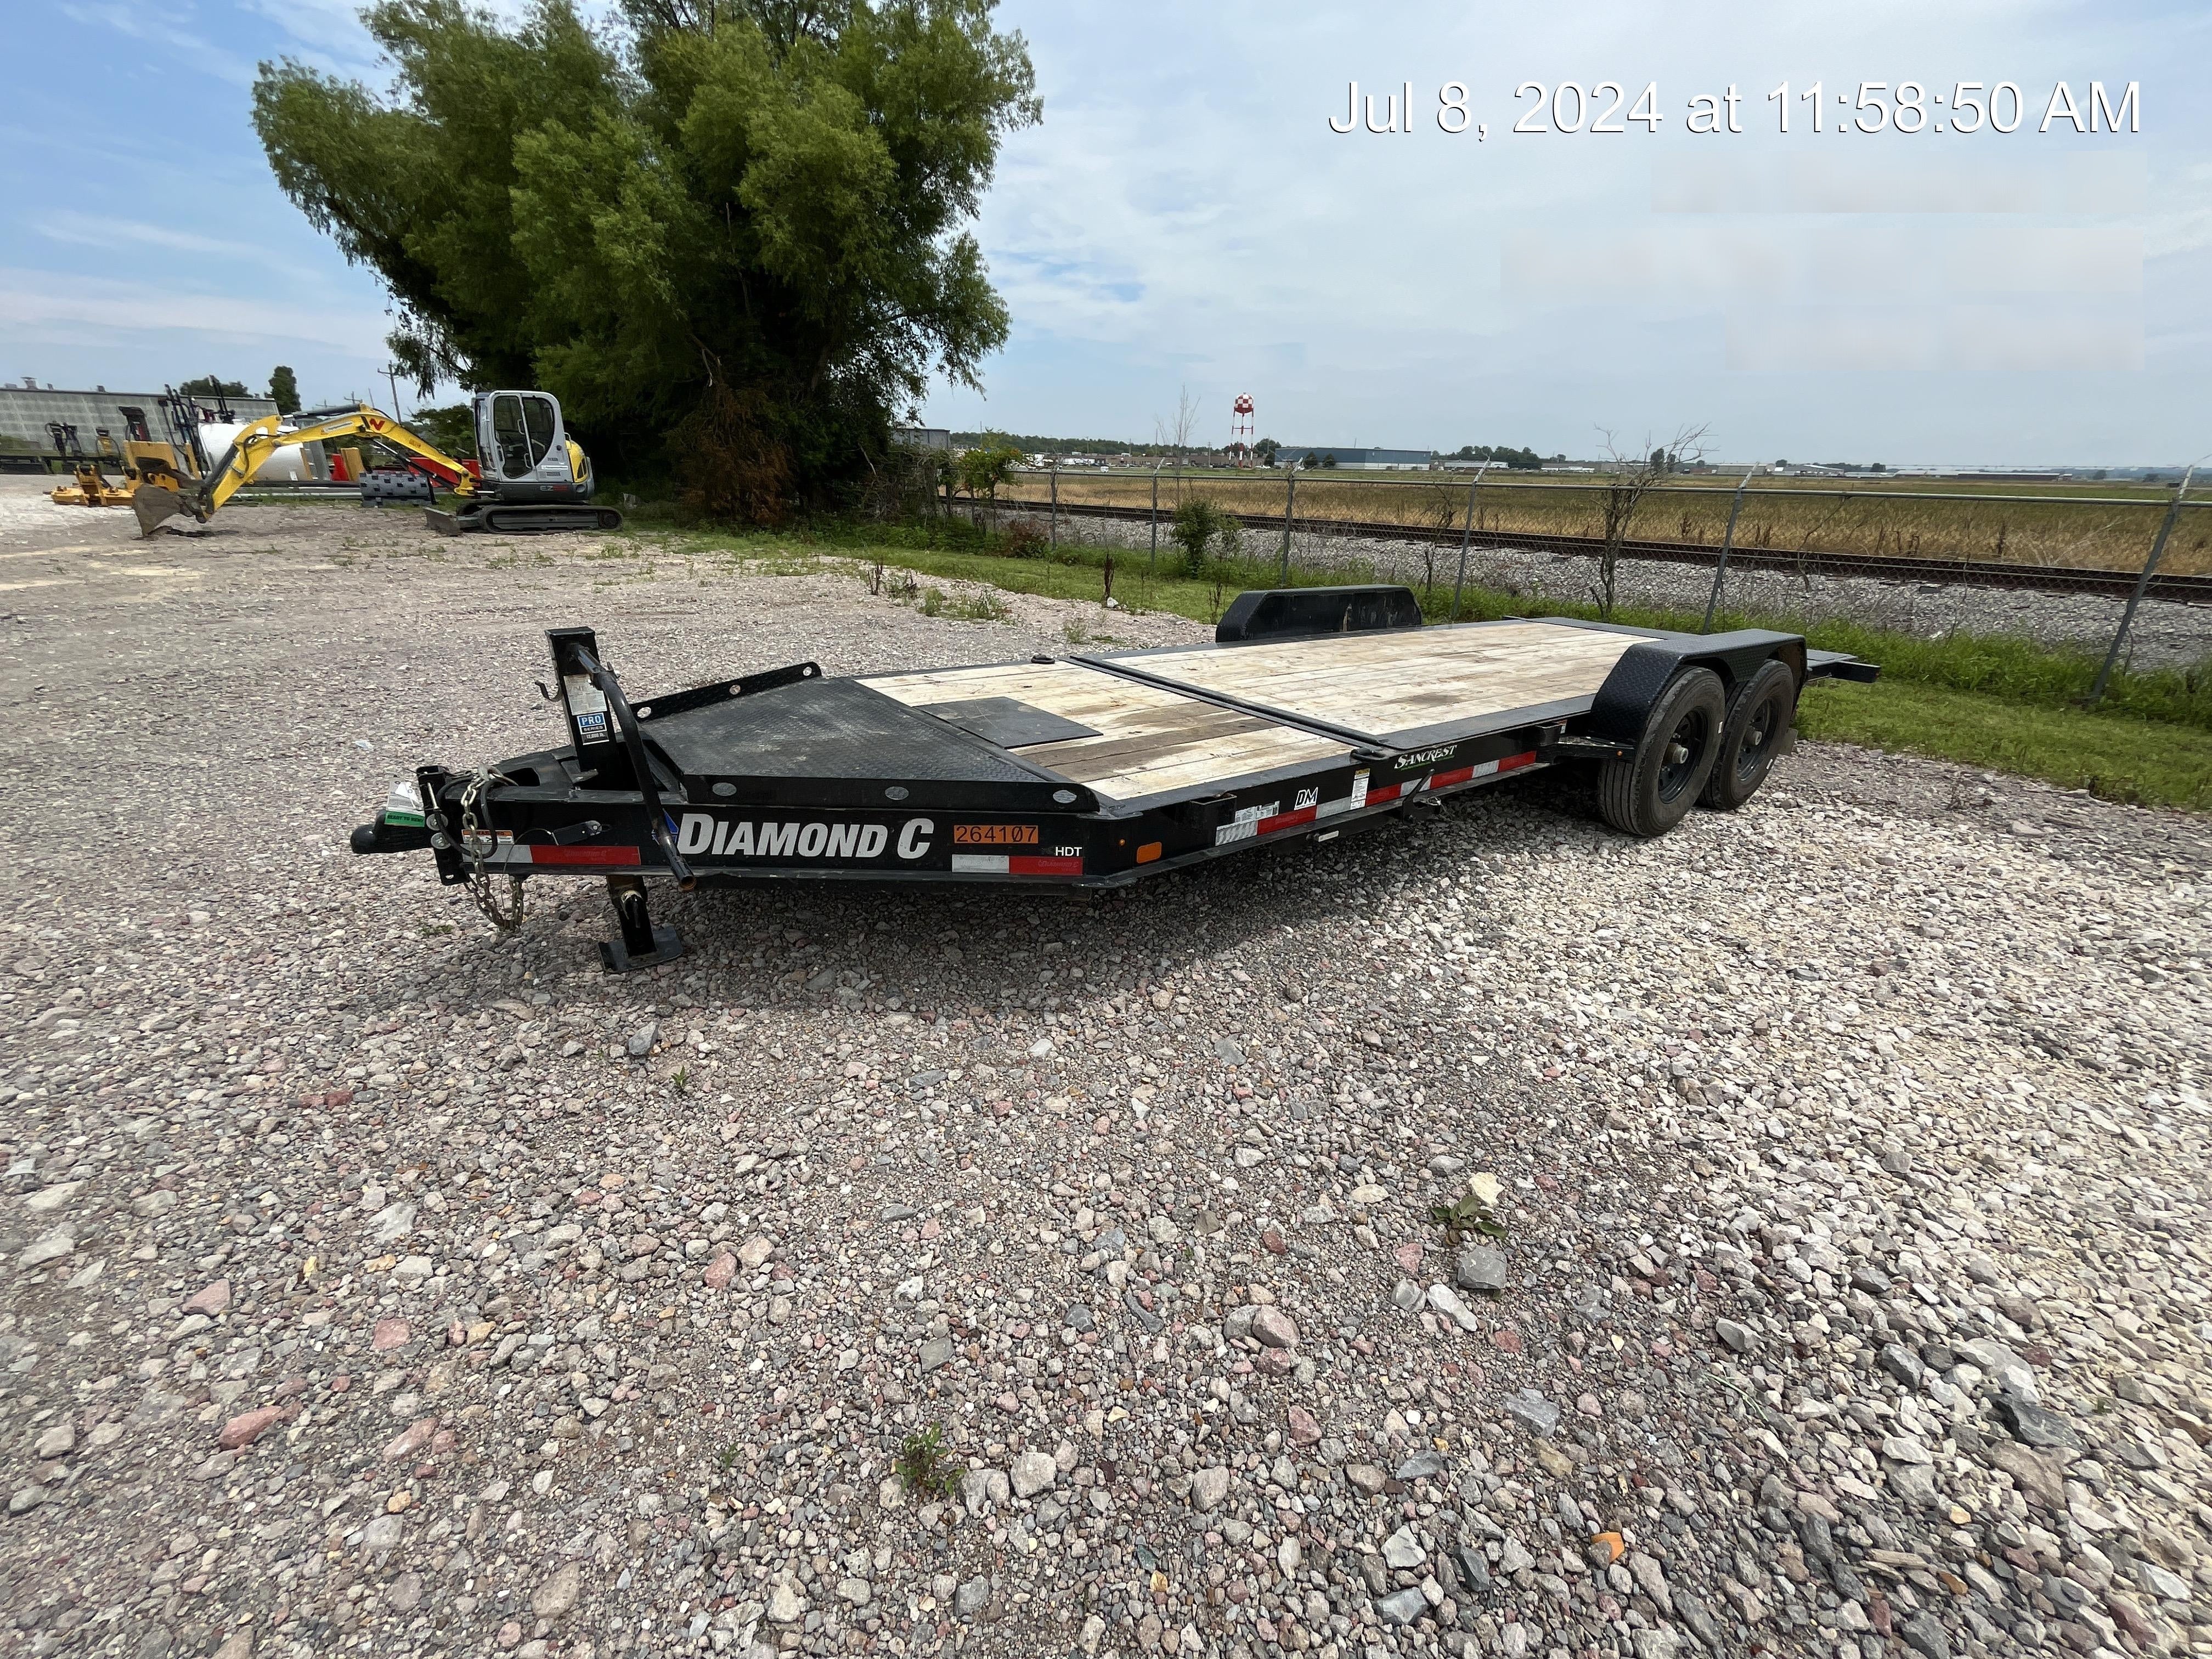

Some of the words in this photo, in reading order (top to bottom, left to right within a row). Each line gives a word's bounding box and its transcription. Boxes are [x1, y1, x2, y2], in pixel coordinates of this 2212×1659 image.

[582, 715, 602, 726] PRO
[1394, 745, 1458, 769] SANCREST
[1296, 787, 1318, 806] DM
[896, 817, 934, 859] C
[956, 826, 1037, 843] 264107
[1055, 847, 1083, 856] HDT
